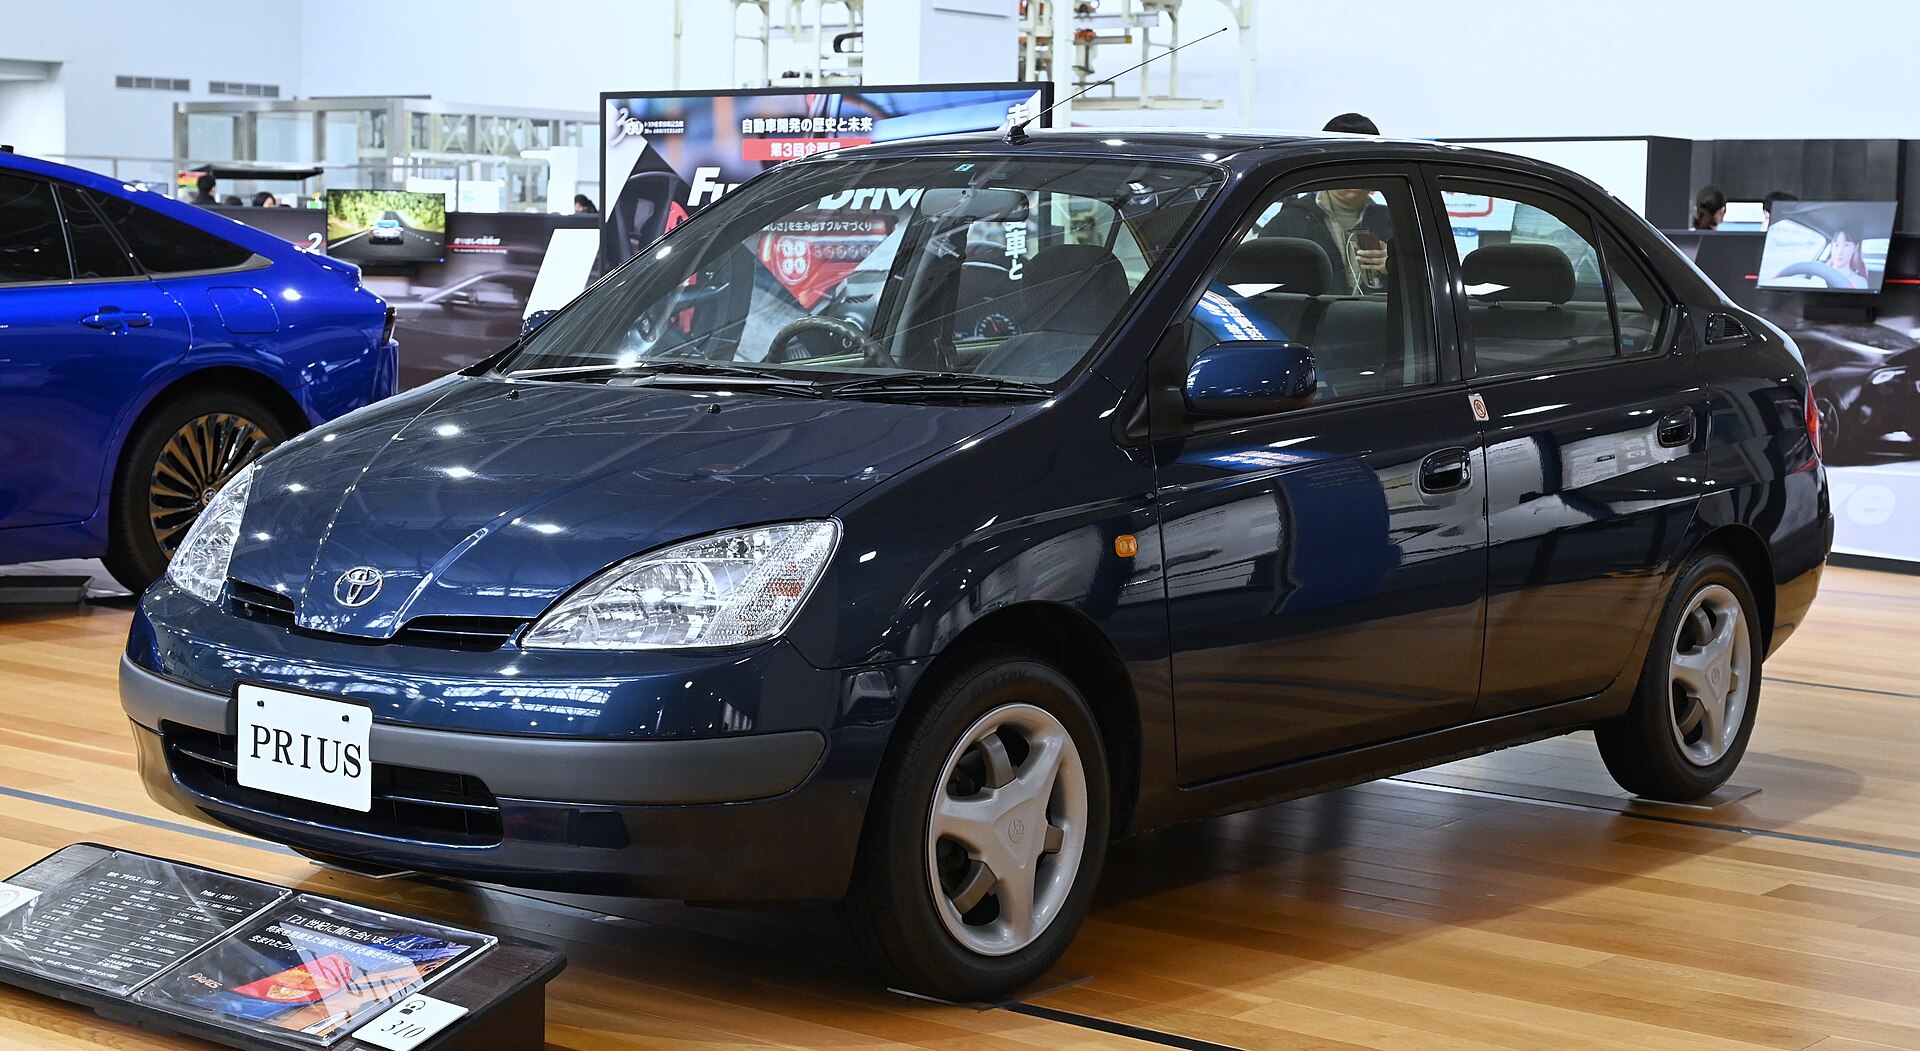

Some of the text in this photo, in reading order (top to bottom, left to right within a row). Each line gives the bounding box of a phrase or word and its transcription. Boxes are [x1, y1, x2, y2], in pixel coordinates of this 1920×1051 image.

[742, 117, 873, 133] 自動車開発の歴史と未来
[250, 724, 362, 778] PRIUS
[380, 1020, 426, 1038] 310
